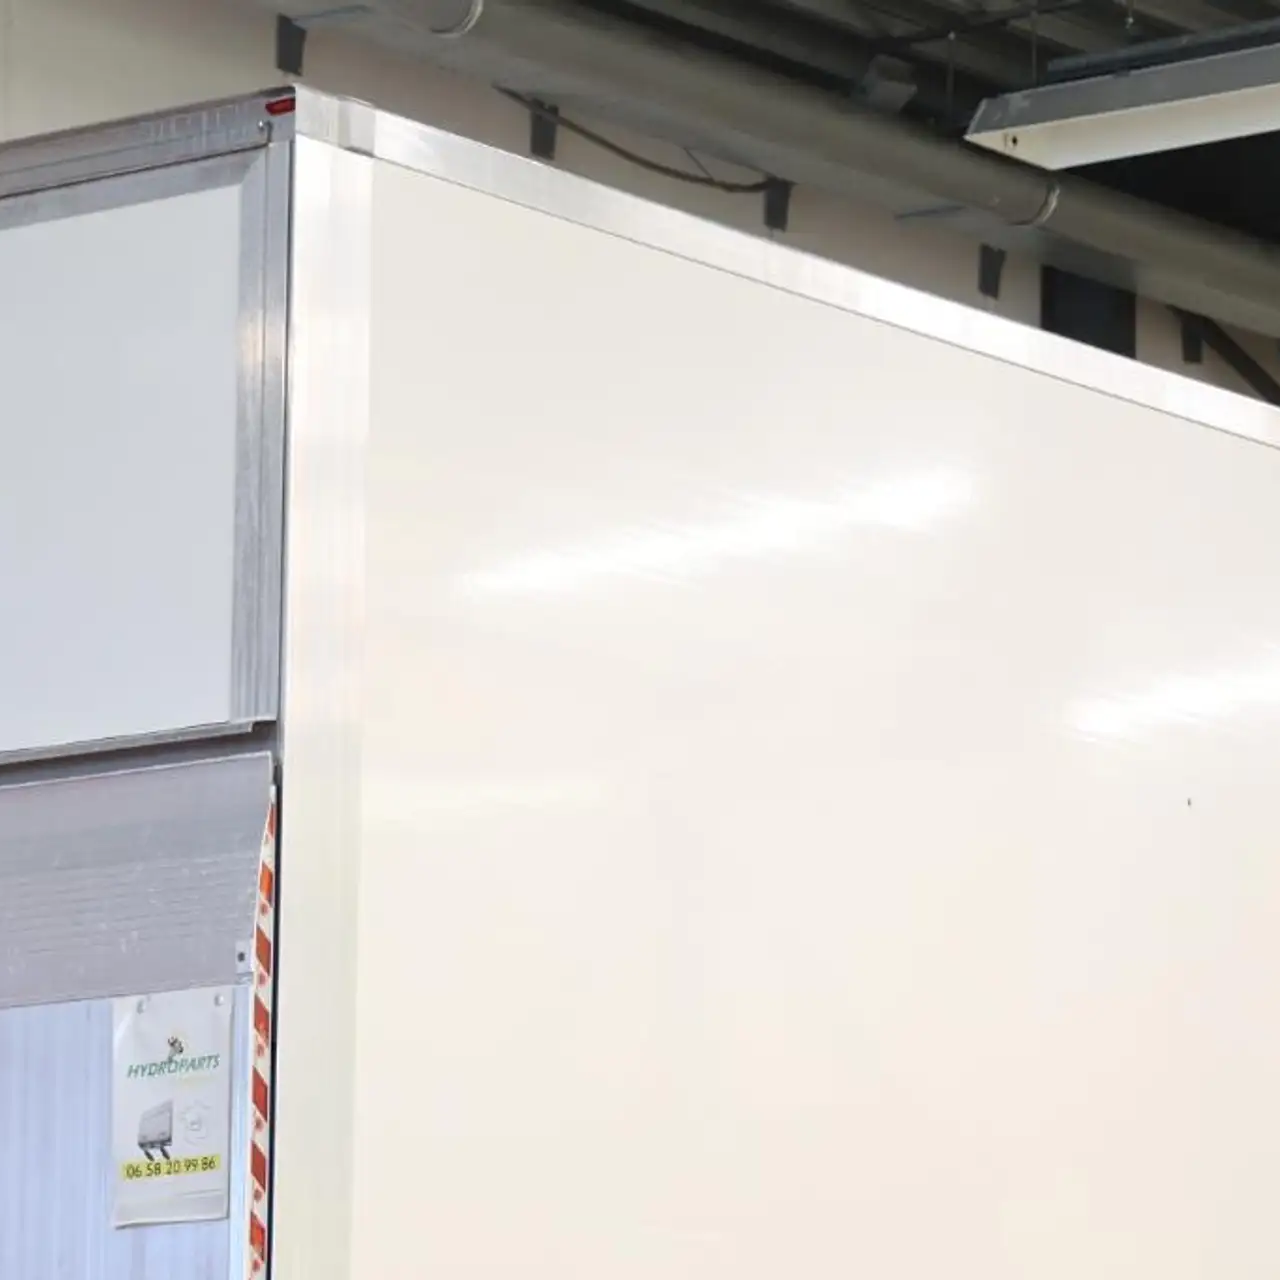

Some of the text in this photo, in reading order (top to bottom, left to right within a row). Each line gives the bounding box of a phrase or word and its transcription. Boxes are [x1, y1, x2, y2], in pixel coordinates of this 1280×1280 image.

[126, 1052, 219, 1078] HYDROPARTS
[126, 1156, 217, 1180] 06 58 20 99 86
